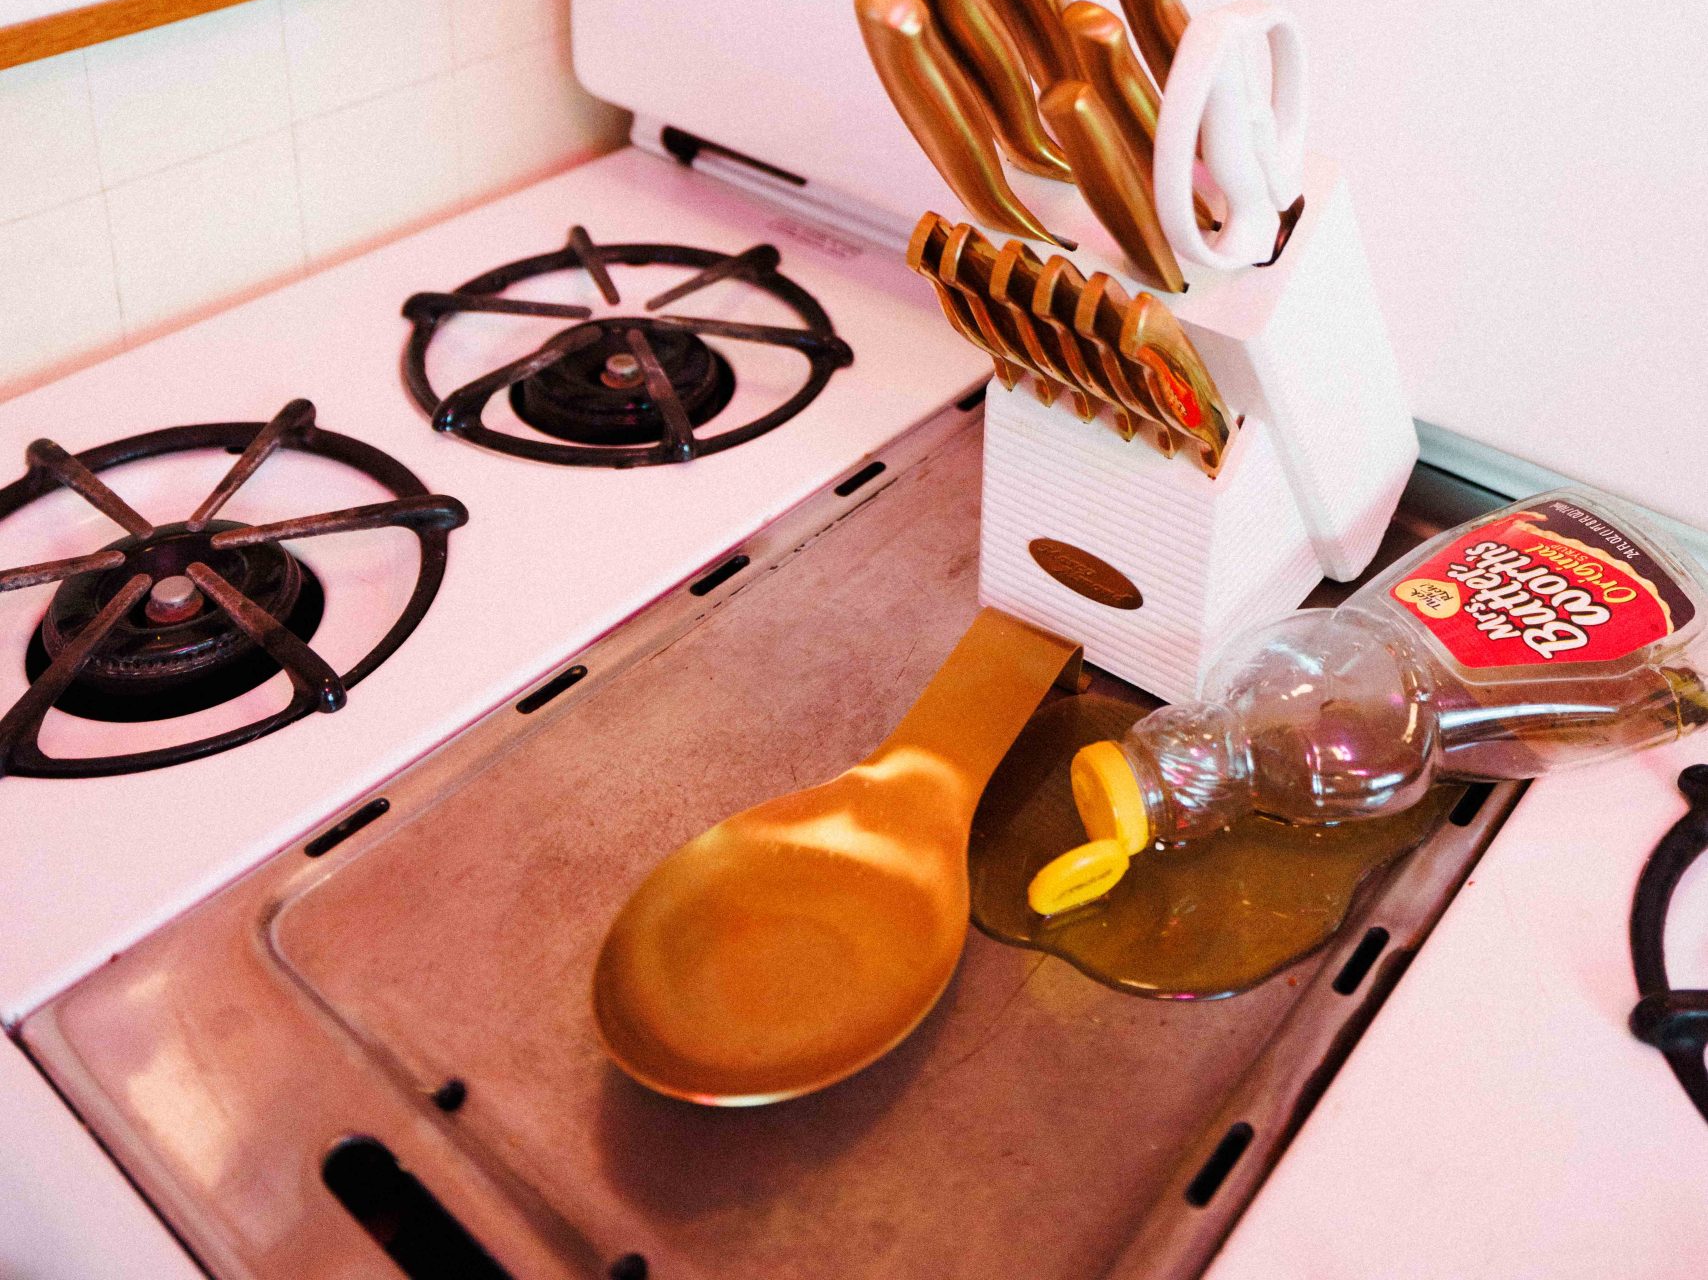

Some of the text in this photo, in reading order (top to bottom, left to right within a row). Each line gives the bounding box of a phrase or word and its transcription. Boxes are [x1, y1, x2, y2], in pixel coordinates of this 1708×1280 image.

[1589, 523, 1605, 532] PT
[1605, 534, 1622, 545] OZ
[1616, 541, 1631, 551] FL
[1550, 544, 1588, 562] SYRUP
[1623, 548, 1641, 559] 24
[1524, 543, 1638, 603] Original
[1411, 588, 1438, 610] Thick
[1420, 584, 1454, 601] Rich!
[1464, 598, 1522, 641] Mrs.
